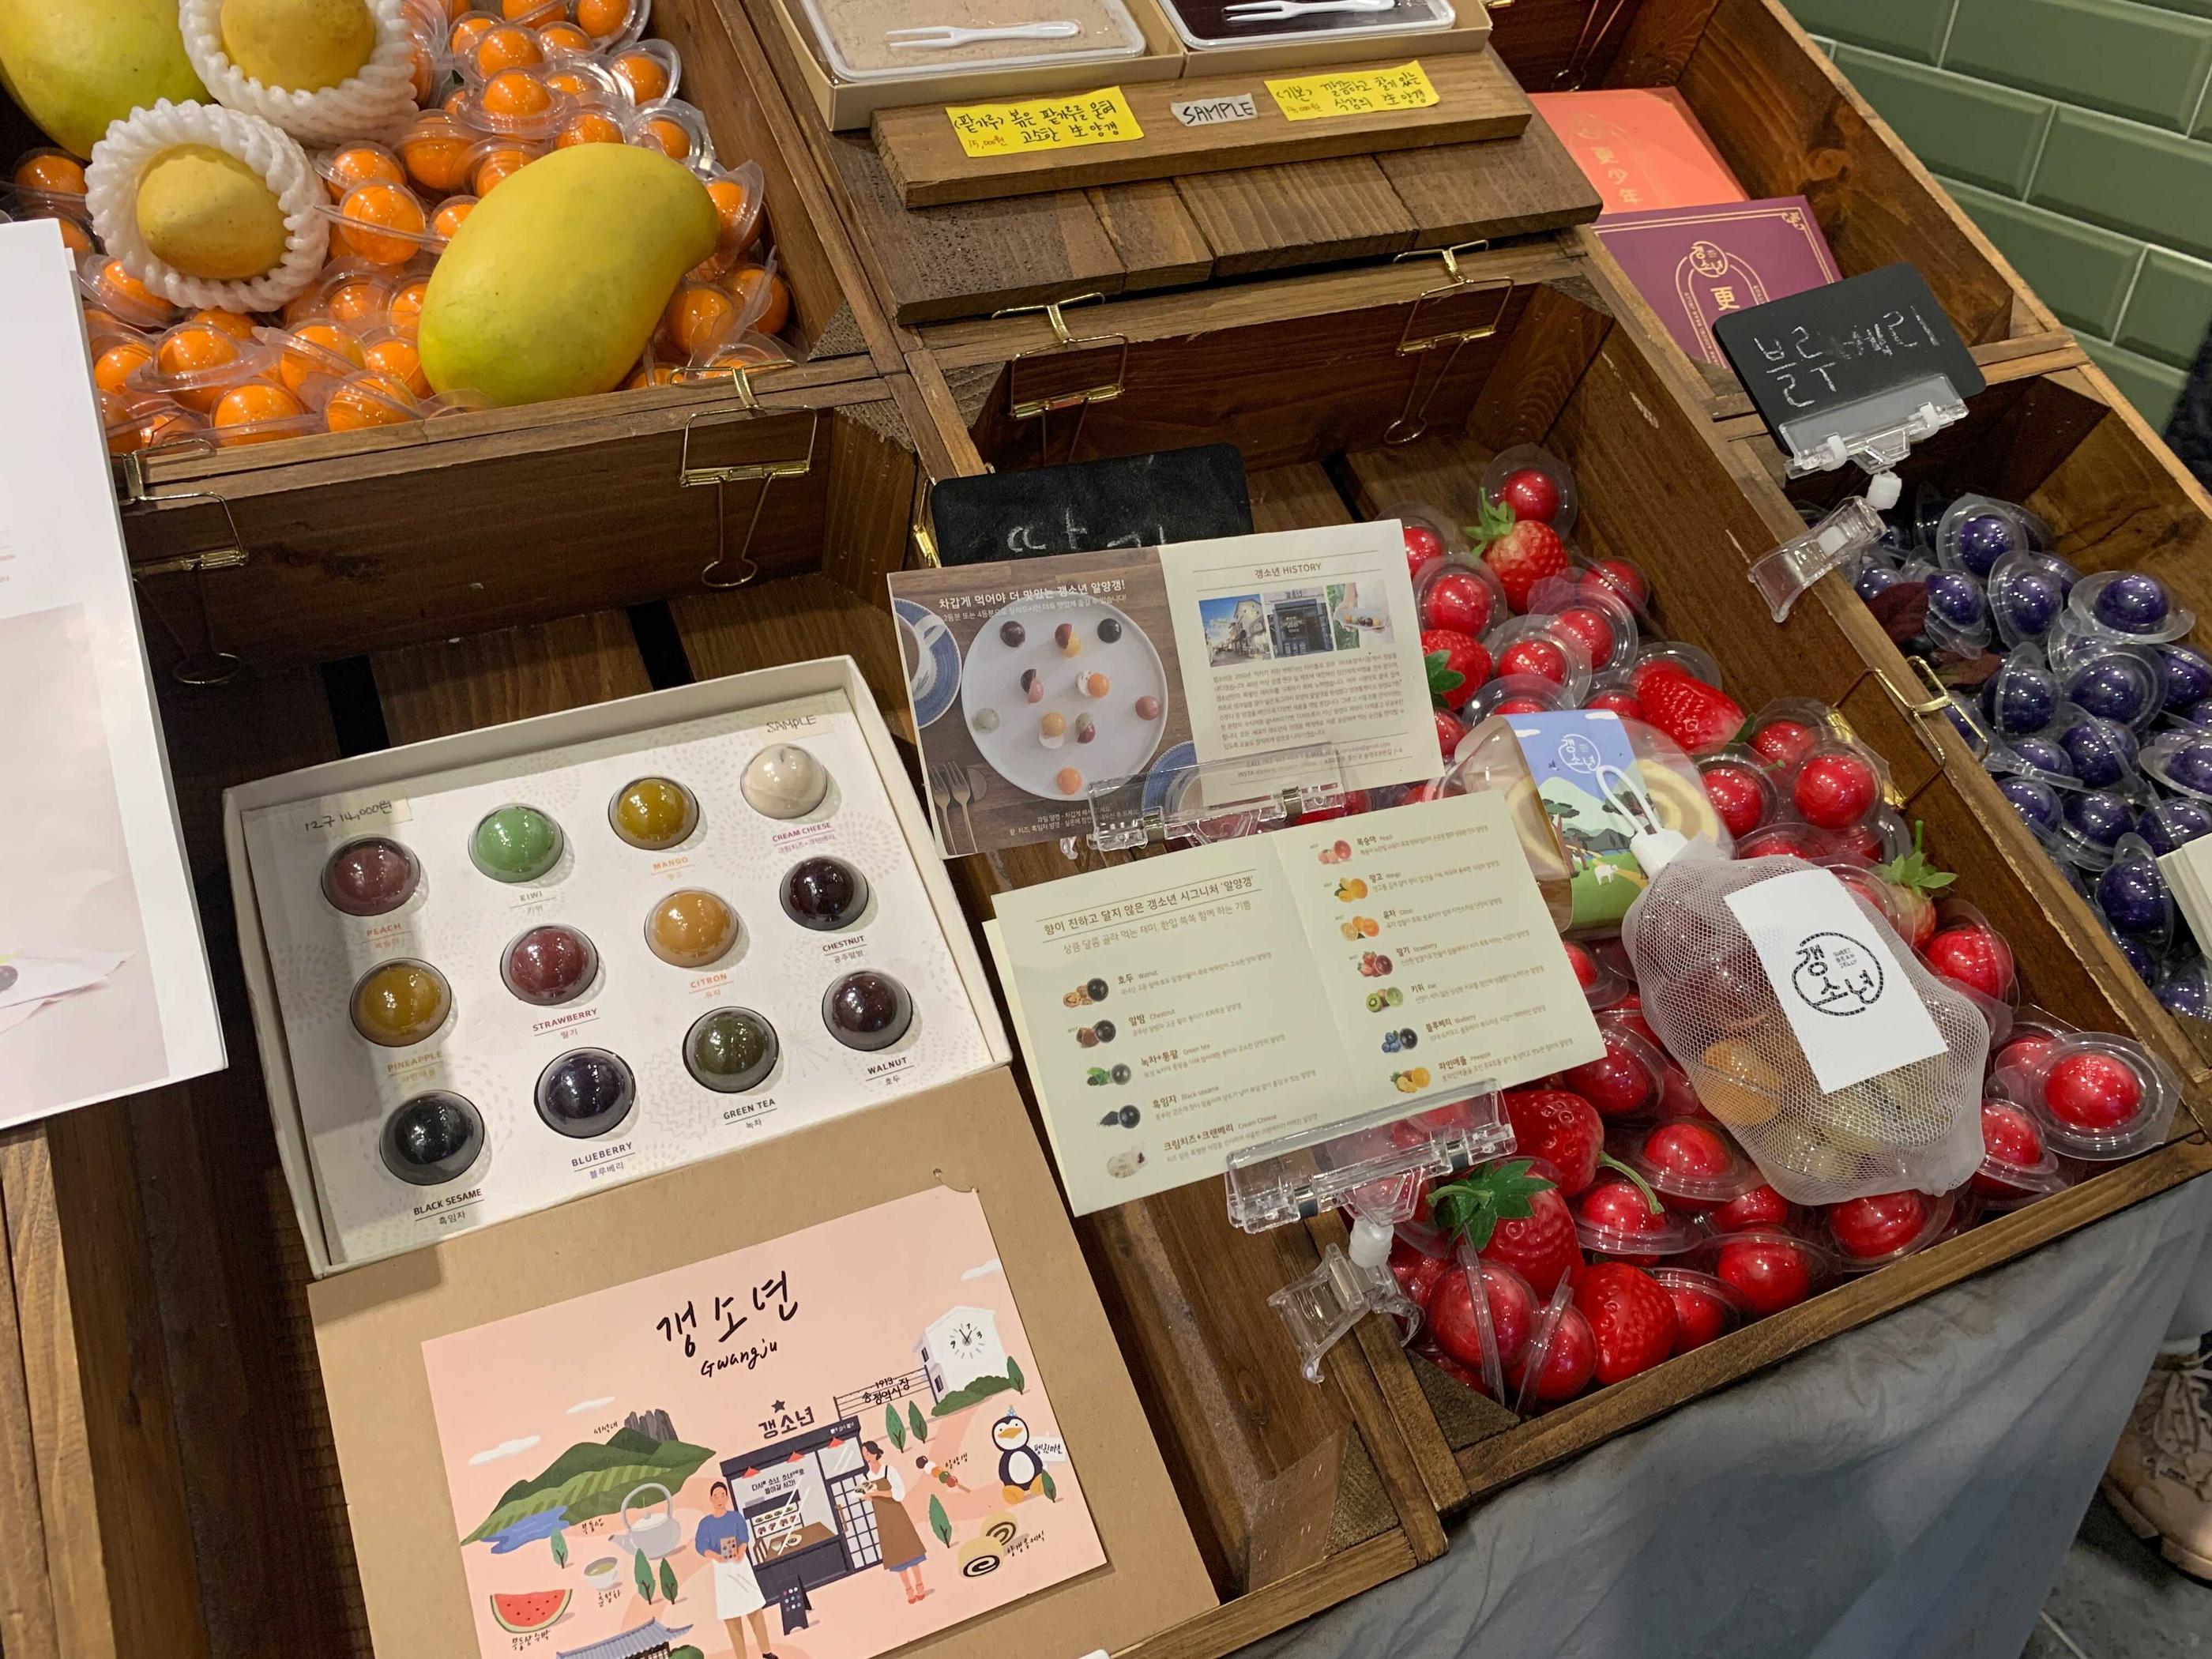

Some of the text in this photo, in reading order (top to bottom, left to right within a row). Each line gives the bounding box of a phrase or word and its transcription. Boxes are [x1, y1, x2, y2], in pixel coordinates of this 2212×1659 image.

[1320, 81, 1372, 96] 깔끔하고
[1399, 71, 1421, 87] 있는
[1183, 101, 1254, 124] SAMPLE
[1335, 96, 1373, 111] 식감의
[1040, 105, 1089, 125] 팥가루를
[1020, 127, 1061, 144] 고소한
[1089, 121, 1119, 137] 양갱
[1254, 562, 1322, 580] 갱소년 HISTORY
[939, 578, 1126, 611] 차갑게 먹어야 더 맛있는 갱소년 알양갱!
[766, 714, 817, 733] SAMPLE
[340, 799, 393, 822] 14,000원
[772, 821, 833, 843] CREAM CHEESE
[1356, 834, 1377, 847] 복숭아
[653, 856, 689, 871] MANGO
[1368, 872, 1383, 884] 망고
[519, 890, 544, 902] KIWI
[1044, 918, 1066, 936] 향이
[1068, 912, 1100, 931] 진하고
[1100, 907, 1123, 924] 달지
[1123, 901, 1145, 917] 않은
[1146, 893, 1178, 912] 갱소년
[1180, 882, 1220, 902] 시그니처
[1382, 909, 1397, 920] 유자
[366, 922, 402, 938] PEACH
[1120, 926, 1138, 942] 먹는
[822, 935, 865, 953] CHESTNUT
[1396, 946, 1411, 957] 딸기
[690, 972, 728, 989] CITRON
[1117, 972, 1134, 986] 호두
[1410, 984, 1425, 994] 키위
[532, 1007, 599, 1033] STRAWBERRY
[1127, 1014, 1146, 1027] 알밤
[1425, 1018, 1452, 1033] 블루베리
[559, 1028, 579, 1040] 딸기
[387, 1050, 444, 1073] PINEAPPLE
[867, 1057, 908, 1076] WALNUT
[1141, 1048, 1179, 1068] 녹차+통팥
[1438, 1055, 1467, 1071] 파인애플
[885, 1074, 901, 1086] 호두
[723, 1097, 777, 1121] GREEN TEA
[1152, 1093, 1178, 1110] 흑임자
[745, 1118, 762, 1130] 녹차
[1163, 1122, 1235, 1152] 크림치즈+크랜베리
[570, 1141, 634, 1168] BLUEBERRY
[589, 1161, 625, 1180] 블루베리
[413, 1187, 483, 1217] BLACK SESAME
[438, 1209, 467, 1226] 흑임자
[656, 1270, 798, 1357] 갱소년
[701, 1338, 777, 1378] Gwangju
[862, 1378, 910, 1405] 송정역시장
[758, 1406, 815, 1439] 갱소년
